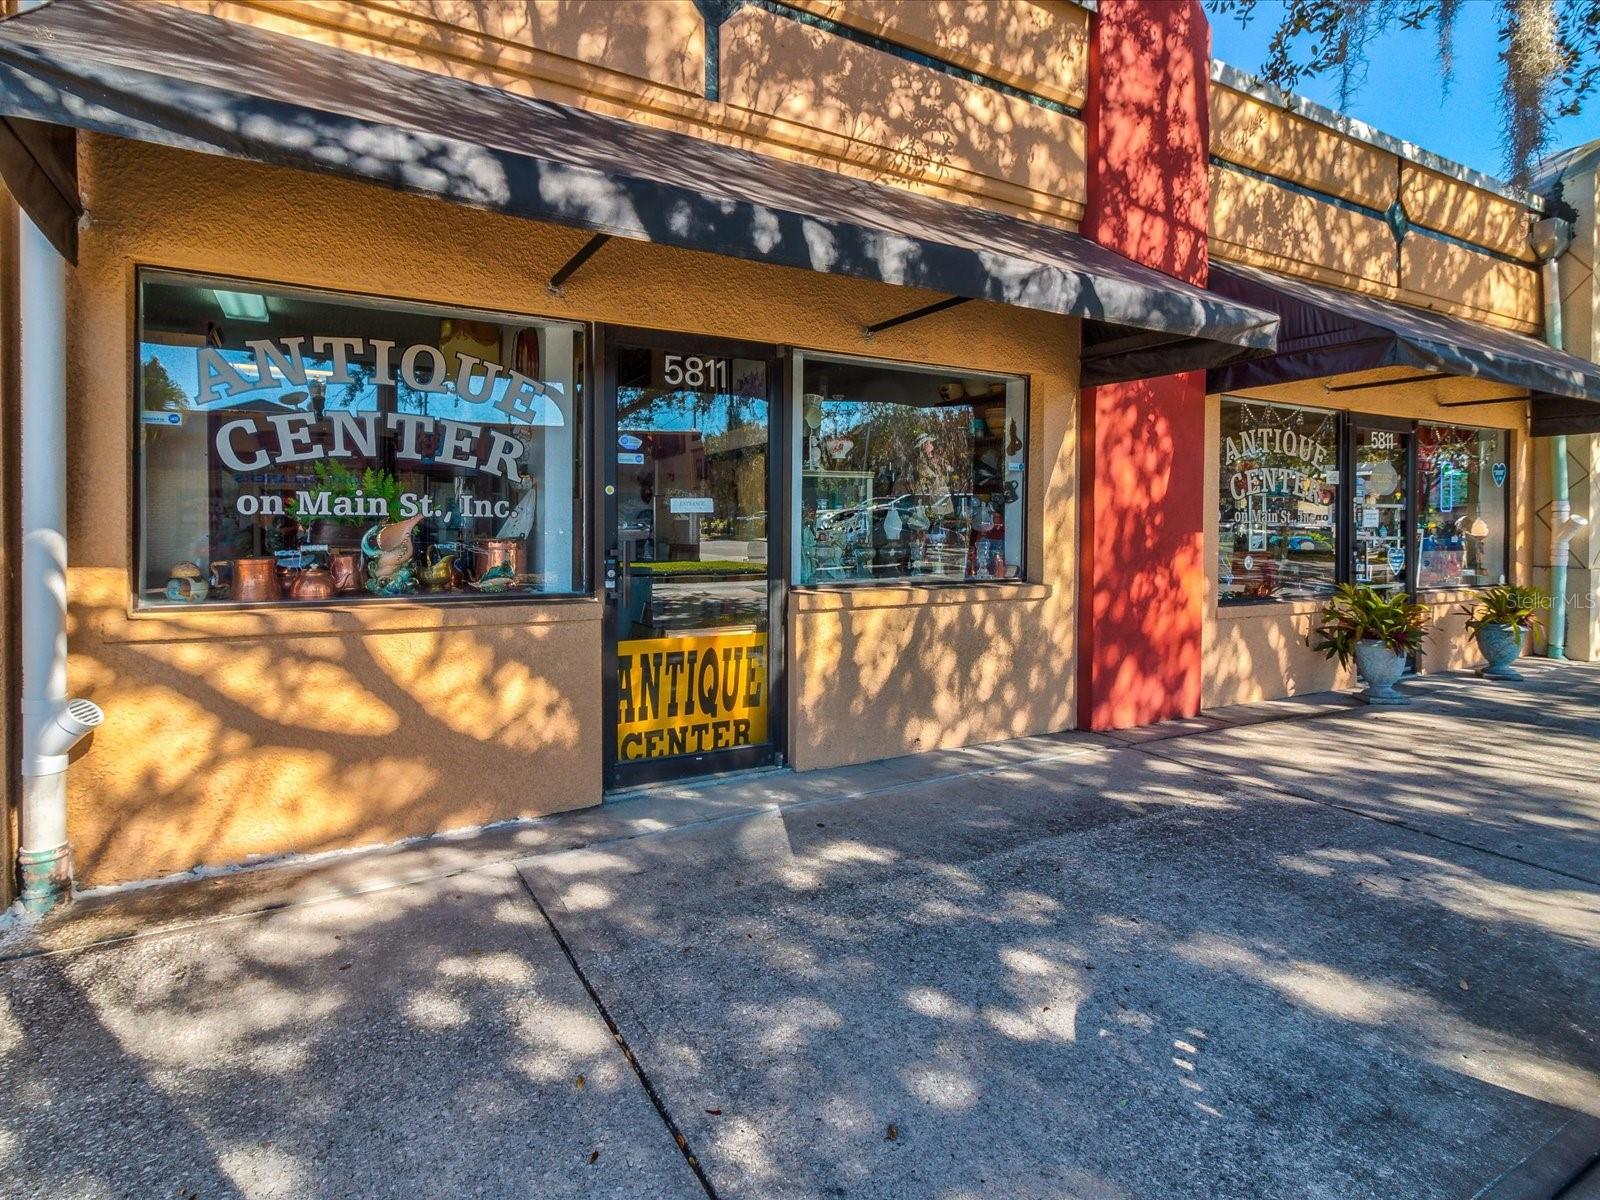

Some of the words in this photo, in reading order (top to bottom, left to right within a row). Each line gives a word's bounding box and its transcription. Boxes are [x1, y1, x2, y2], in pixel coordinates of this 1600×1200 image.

[195, 336, 547, 424] ANTIQUE
[664, 355, 726, 388] 5811
[216, 411, 524, 483] CENTER
[1225, 428, 1327, 471] ANTIQUE
[1371, 432, 1394, 450] 5811
[236, 494, 285, 515] on
[296, 490, 389, 516] Main
[400, 493, 452, 523] St.,
[460, 495, 518, 518] Inc.
[1230, 467, 1320, 506] CENTER
[1234, 511, 1249, 523] on
[1251, 509, 1278, 524] Main
[618, 645, 764, 724] ANTIQUE
[620, 718, 750, 760] CENTER
